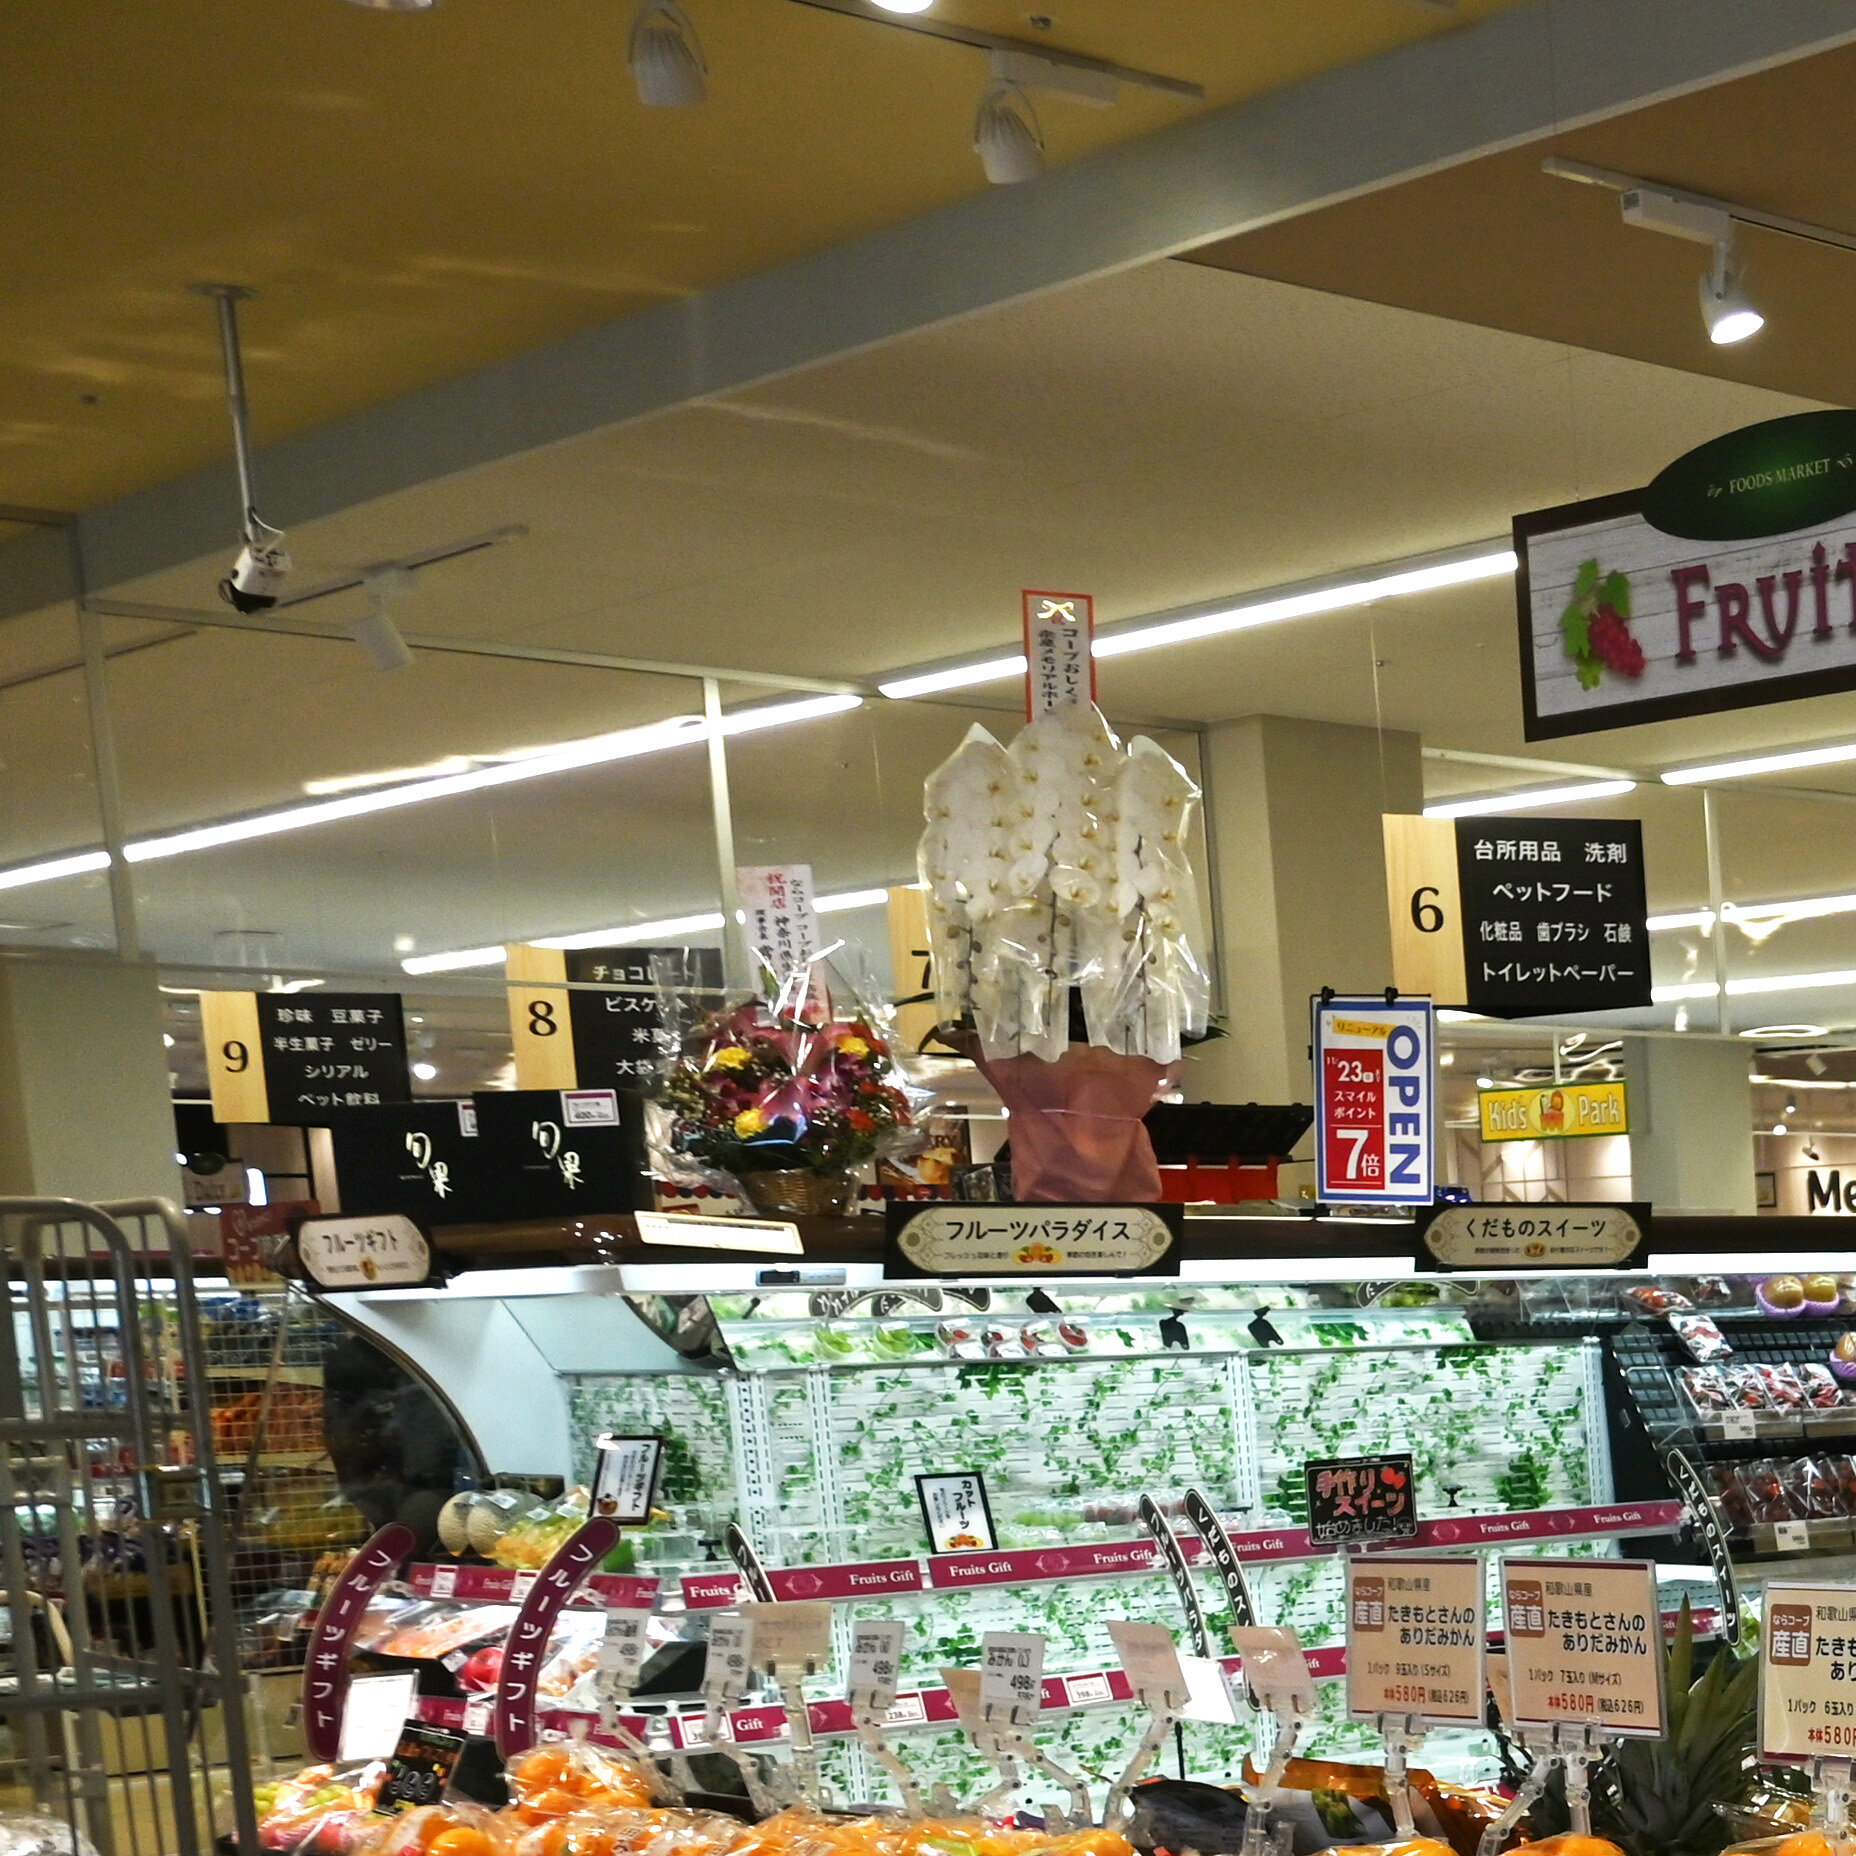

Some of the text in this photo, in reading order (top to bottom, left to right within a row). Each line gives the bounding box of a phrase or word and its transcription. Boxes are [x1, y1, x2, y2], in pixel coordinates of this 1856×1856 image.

[1729, 459, 1830, 495] FOODS MARKET
[1474, 840, 1627, 864] 台所用品 洗剤
[1493, 882, 1612, 903] ペットフード
[1411, 887, 1444, 932] 6
[1480, 921, 1522, 942] 化粧品
[1537, 922, 1590, 942] 歯ブラシ
[1483, 962, 1634, 982] トイレットペーパー
[277, 1009, 384, 1024] 珍味 豆菓子
[528, 1000, 557, 1036] 8
[1336, 1022, 1386, 1036] リニューアル
[273, 1037, 393, 1051] 半生菓子 ゼリー
[223, 1041, 248, 1072] 9
[304, 1065, 369, 1079] シリアル
[1334, 1091, 1376, 1103] スマイル
[1387, 1025, 1420, 1184] OPEN
[1334, 1107, 1376, 1120] ポイント
[1578, 1095, 1620, 1125] Park
[946, 1220, 1130, 1242] フルーツパラダイス
[1466, 1218, 1606, 1238] くだものスイーツ
[322, 1228, 399, 1254] フルーツギフト
[1316, 1469, 1375, 1498] 手作り
[953, 1492, 969, 1529] フルーツ
[1333, 1492, 1405, 1517] スイーツ
[1480, 1520, 1529, 1533] Fruits Gift
[1263, 1537, 1284, 1549] Gift
[1094, 1548, 1154, 1566] Fruits Gift
[849, 1569, 914, 1586] Fruits Gift
[949, 1561, 1012, 1577] Fruits Gift
[690, 1586, 728, 1598] Fruits
[1354, 1601, 1383, 1625] 産直
[1388, 1605, 1475, 1625] たきもとさんの
[1510, 1605, 1544, 1630] 産直
[1548, 1610, 1645, 1632] たきもとさんの
[313, 1548, 388, 1728] フルーツギフト
[507, 1544, 594, 1731] フルーツギフト
[1400, 1627, 1475, 1647] ありだみかん
[1563, 1633, 1647, 1655] ありだみかん
[1772, 1630, 1809, 1659] 産直
[736, 1717, 763, 1732] Gift
